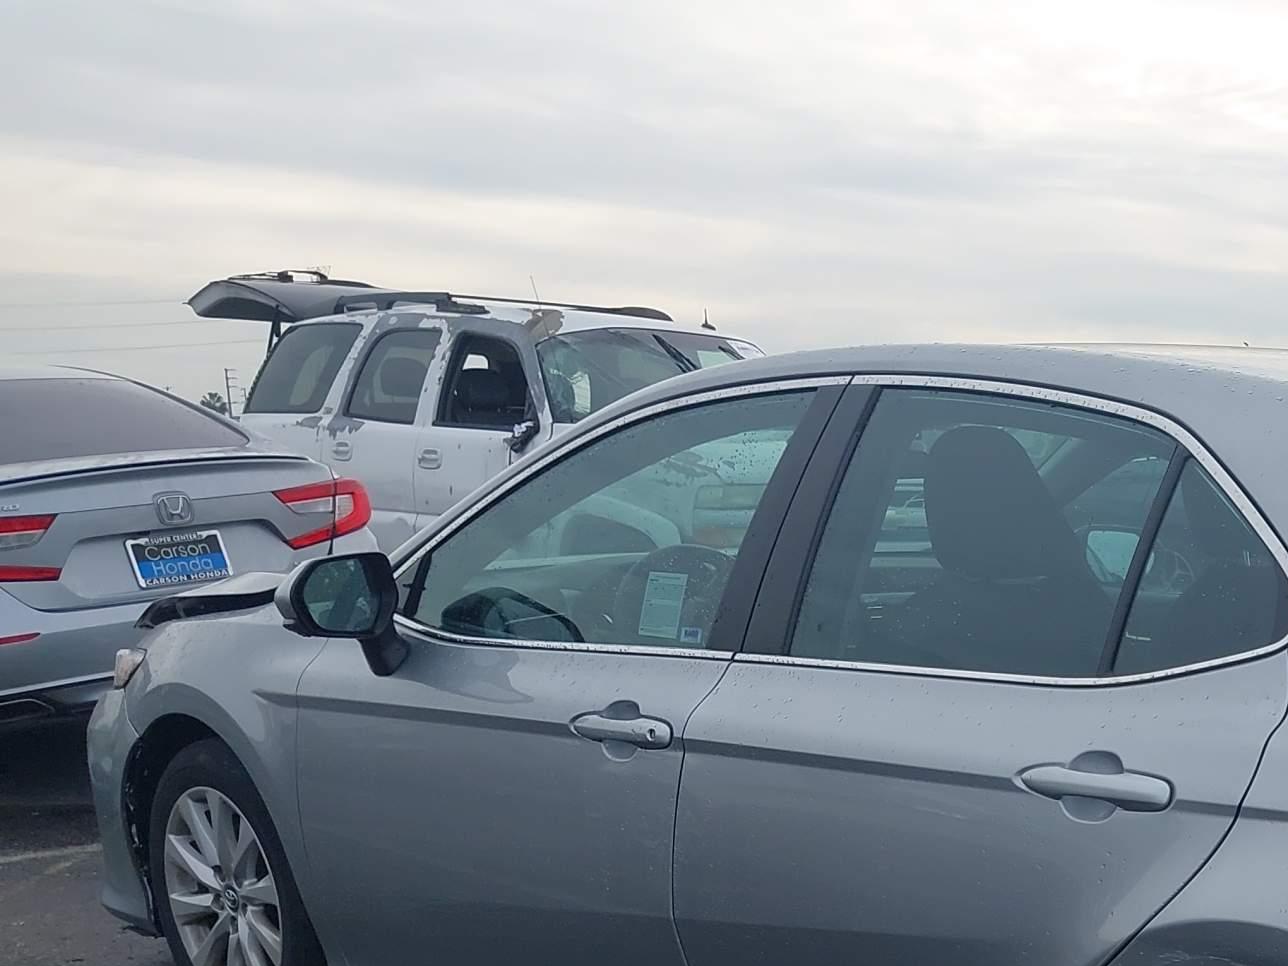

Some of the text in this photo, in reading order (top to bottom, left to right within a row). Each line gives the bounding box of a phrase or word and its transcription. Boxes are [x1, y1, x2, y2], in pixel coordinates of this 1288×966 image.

[145, 543, 211, 561] Carson
[151, 557, 214, 577] Honda
[146, 568, 229, 586] CARSON HONDA
